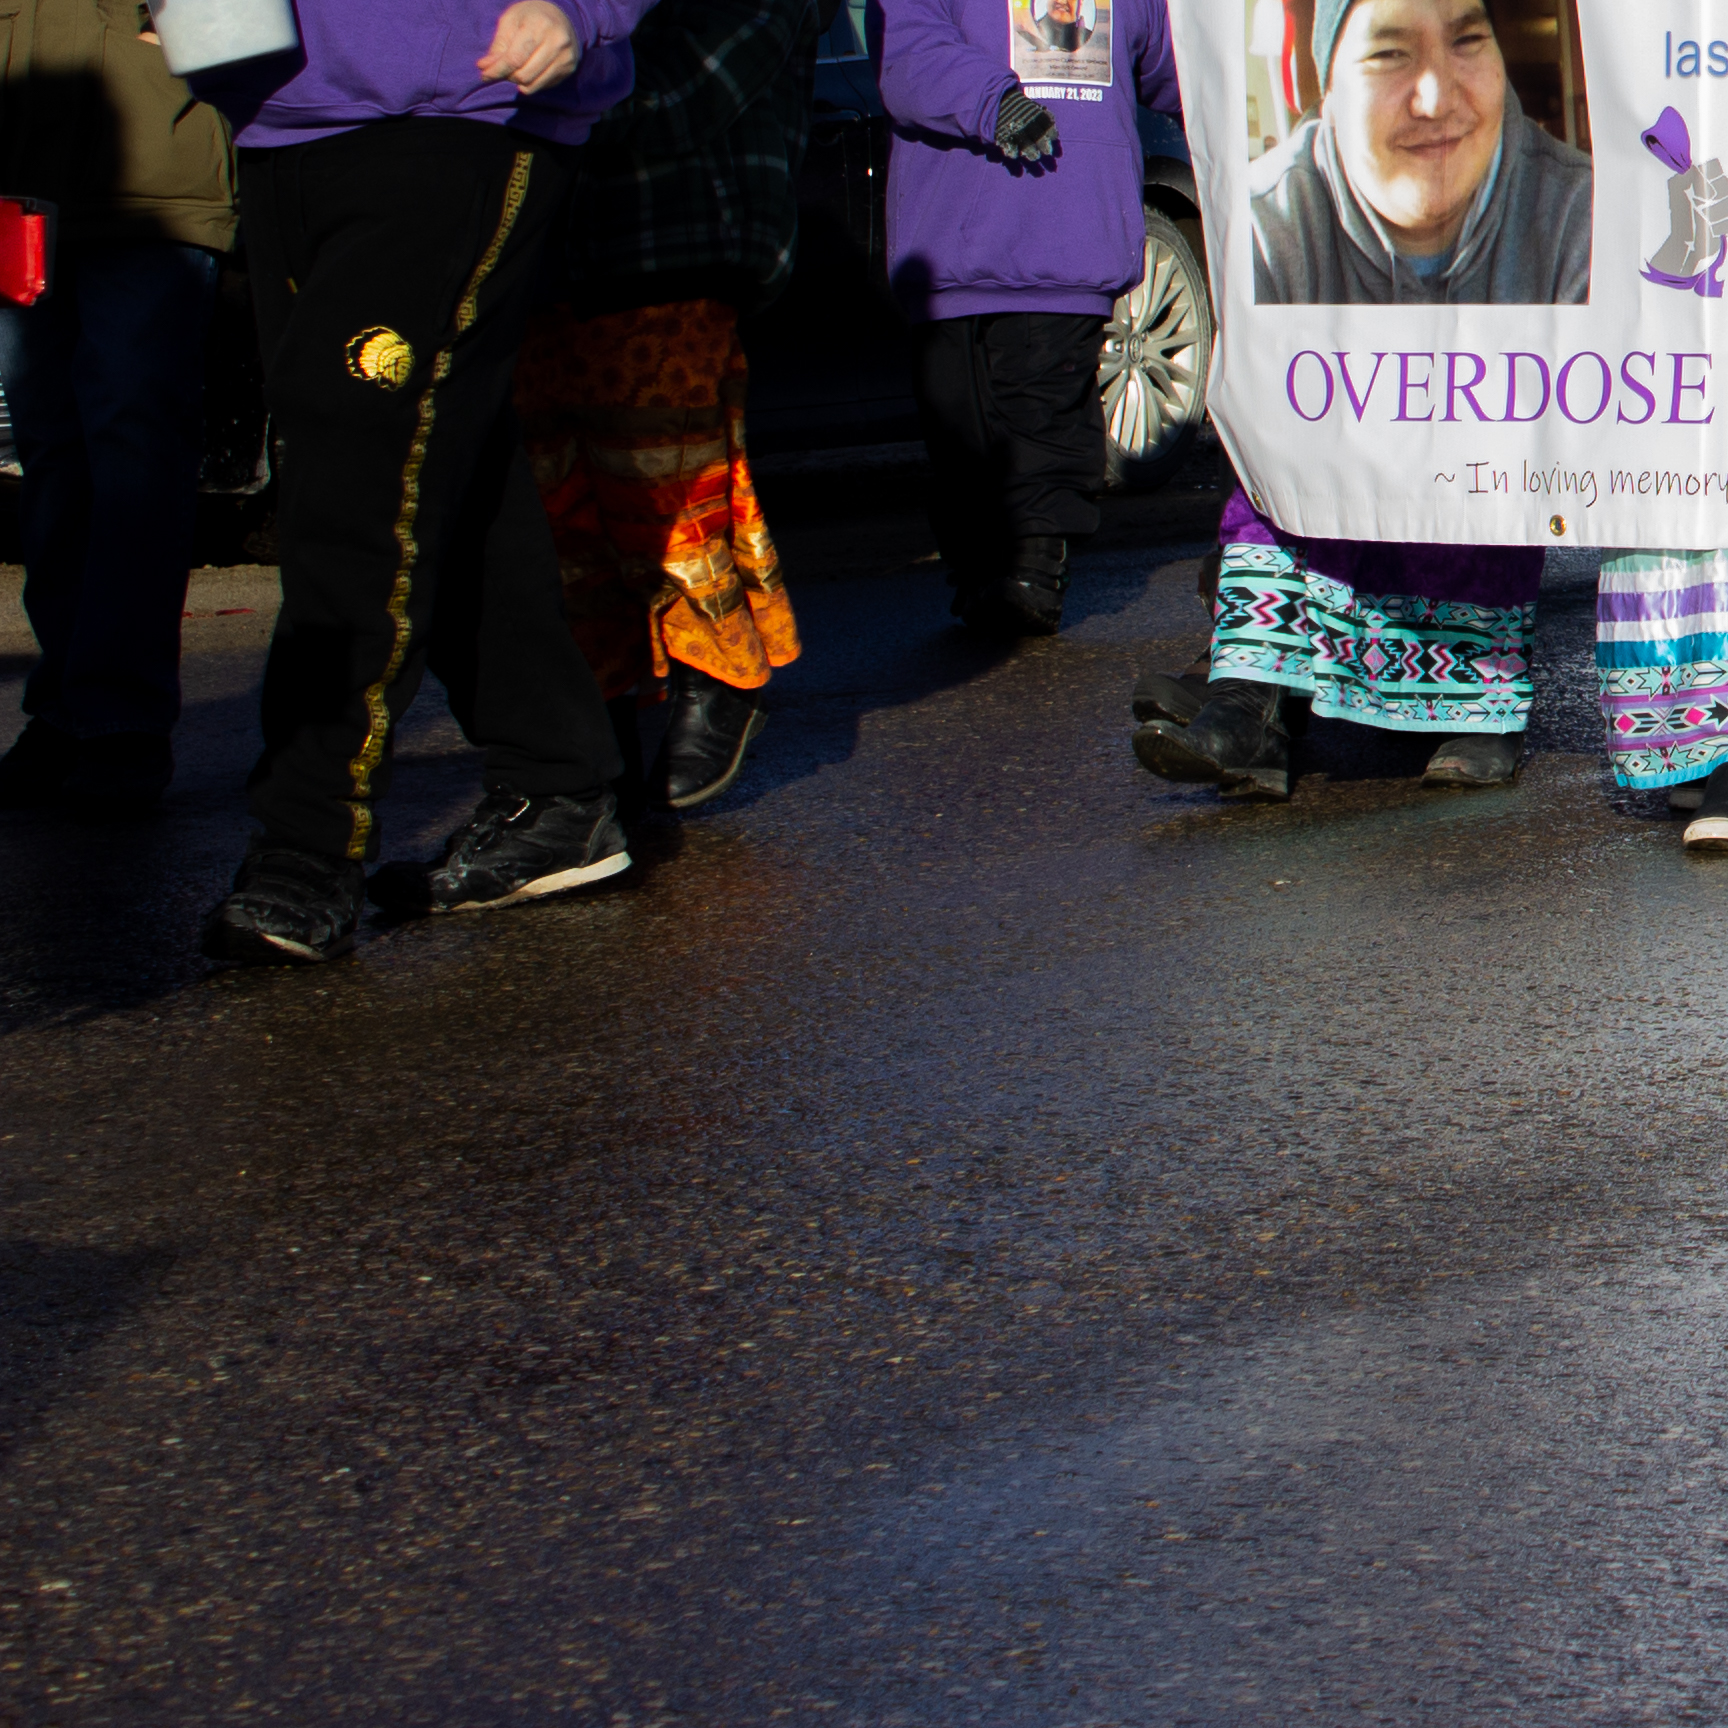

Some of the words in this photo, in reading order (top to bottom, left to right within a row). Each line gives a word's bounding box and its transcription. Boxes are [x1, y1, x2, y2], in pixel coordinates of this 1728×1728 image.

[1023, 85, 1066, 100] JANUARY
[1066, 87, 1080, 102] 21,
[1080, 88, 1103, 103] 2023
[1286, 350, 1714, 424] OVERDOSE
[1465, 461, 1508, 494] In
[1522, 460, 1598, 508] loving
